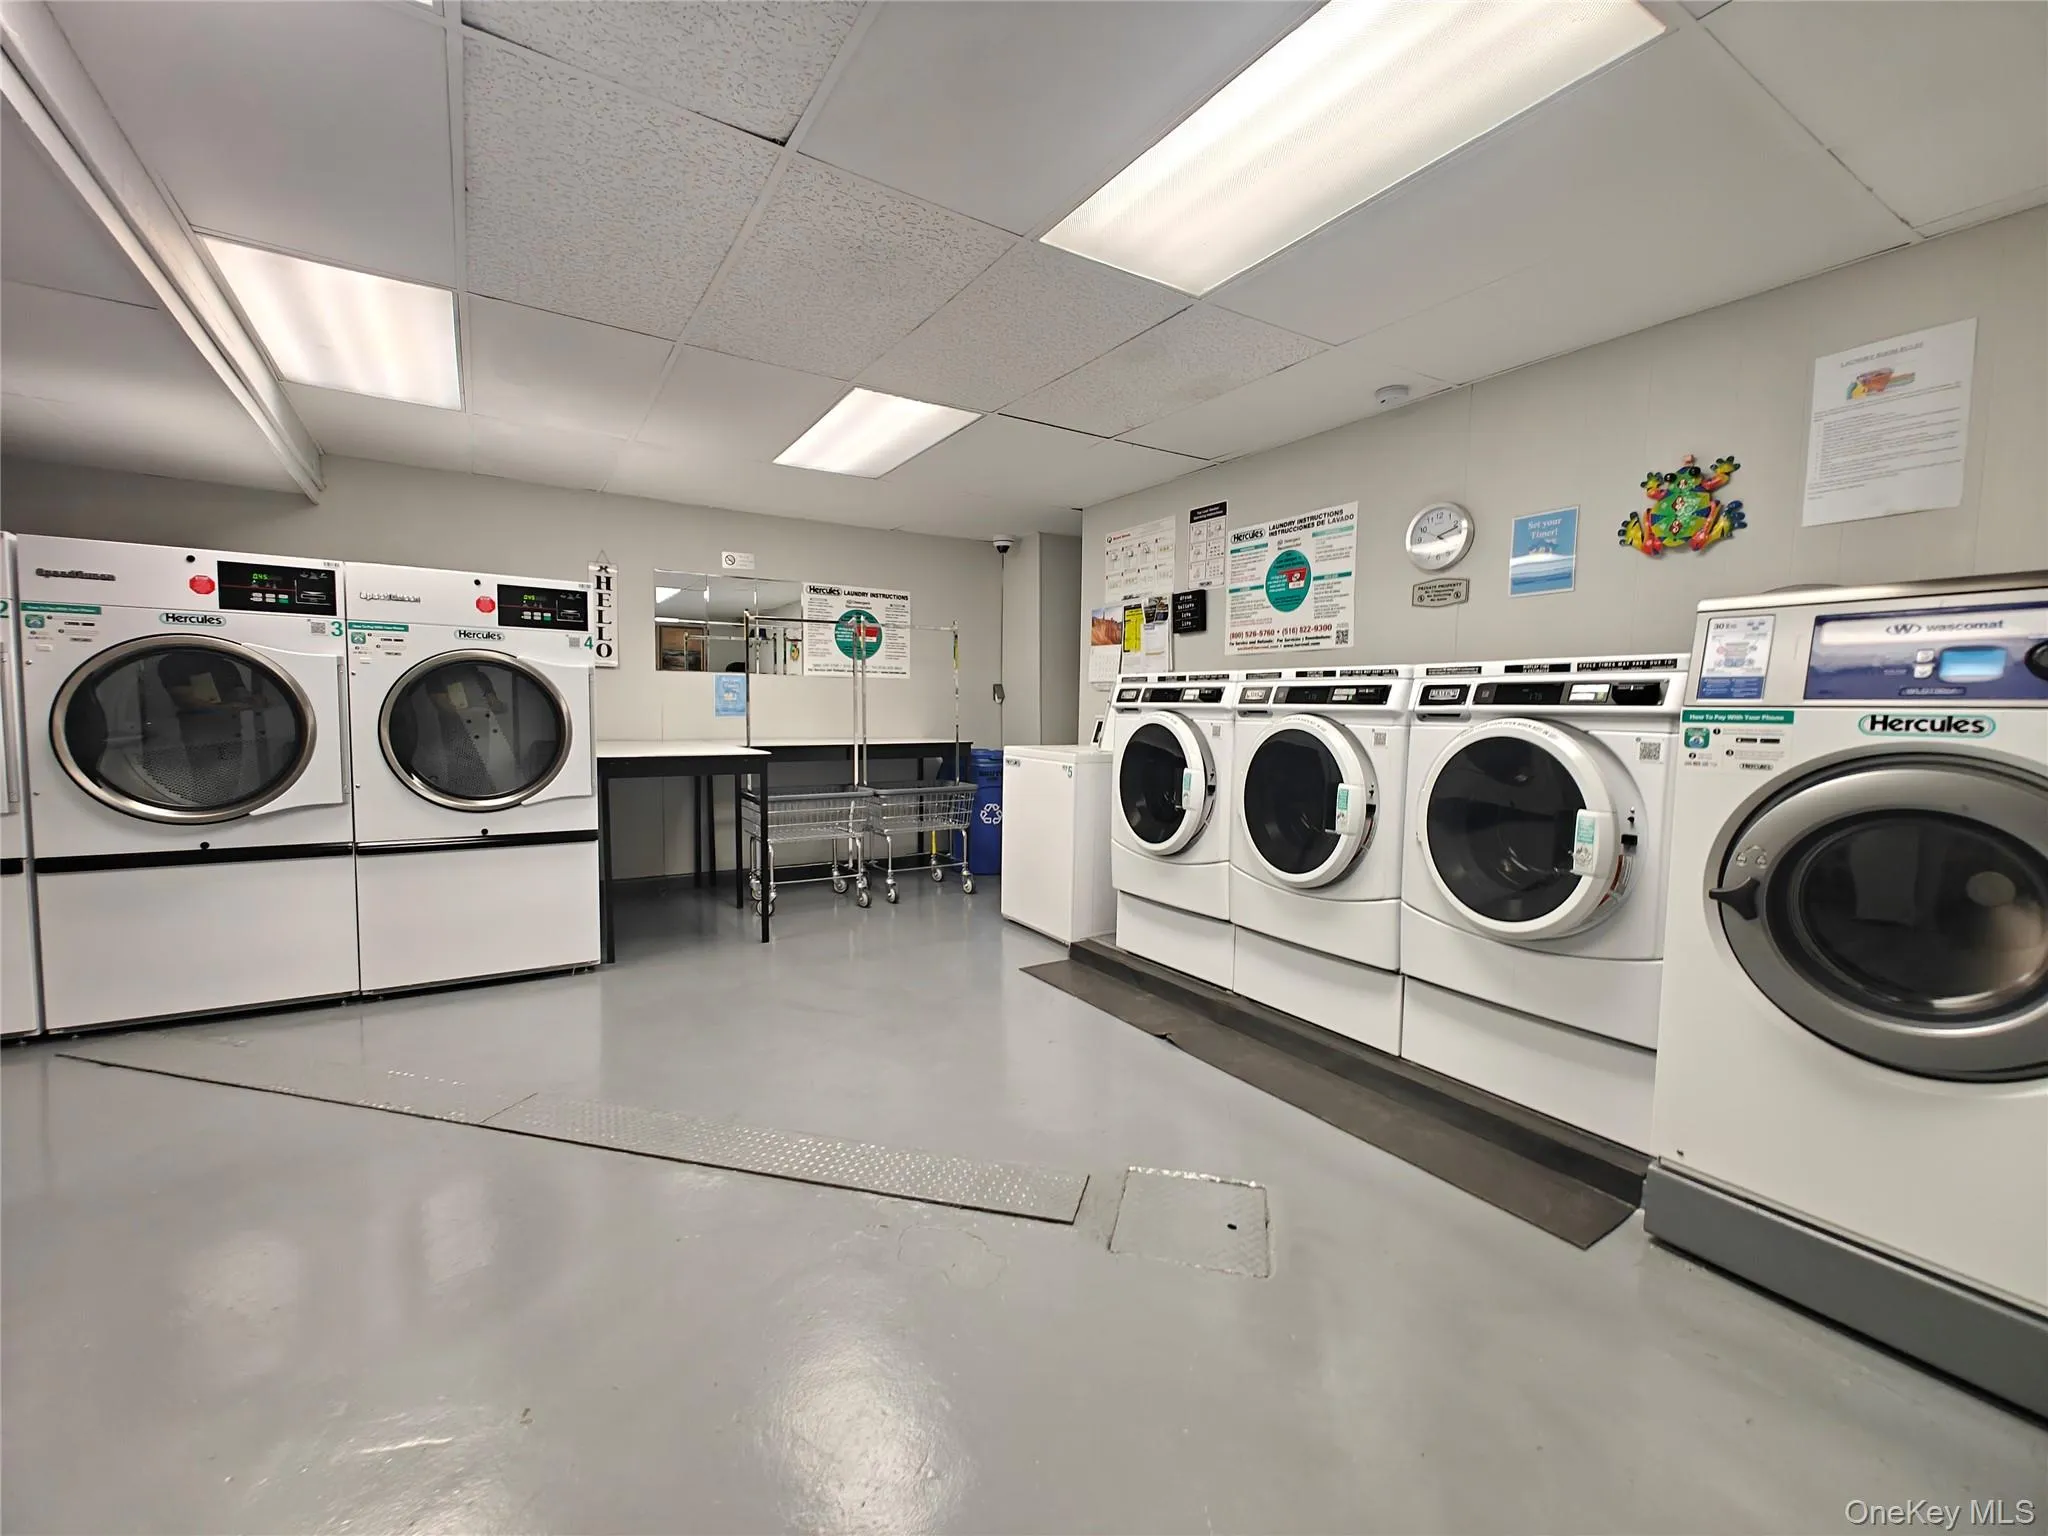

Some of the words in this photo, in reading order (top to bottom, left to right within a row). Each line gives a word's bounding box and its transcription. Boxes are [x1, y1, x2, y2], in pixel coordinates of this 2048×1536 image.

[1268, 520, 1295, 531] LAUNDRY
[1297, 509, 1344, 524] INSTRUCTIONS
[1268, 522, 1315, 537] INSTRUCCIONES
[1327, 514, 1355, 525] LAVADO
[1528, 521, 1541, 529] Set
[1542, 518, 1562, 527] your
[1233, 529, 1264, 542] Hercules
[1531, 528, 1558, 540] Timer!
[809, 585, 840, 596] Hercules
[843, 590, 869, 598] LAUNDRY
[165, 612, 222, 625] Hercules
[594, 575, 613, 658] HELLO
[331, 620, 343, 637] 3
[1926, 619, 2004, 632] wascomat
[458, 629, 502, 641] Hercules
[583, 635, 594, 650] 4
[1870, 714, 1985, 733] Hercules
